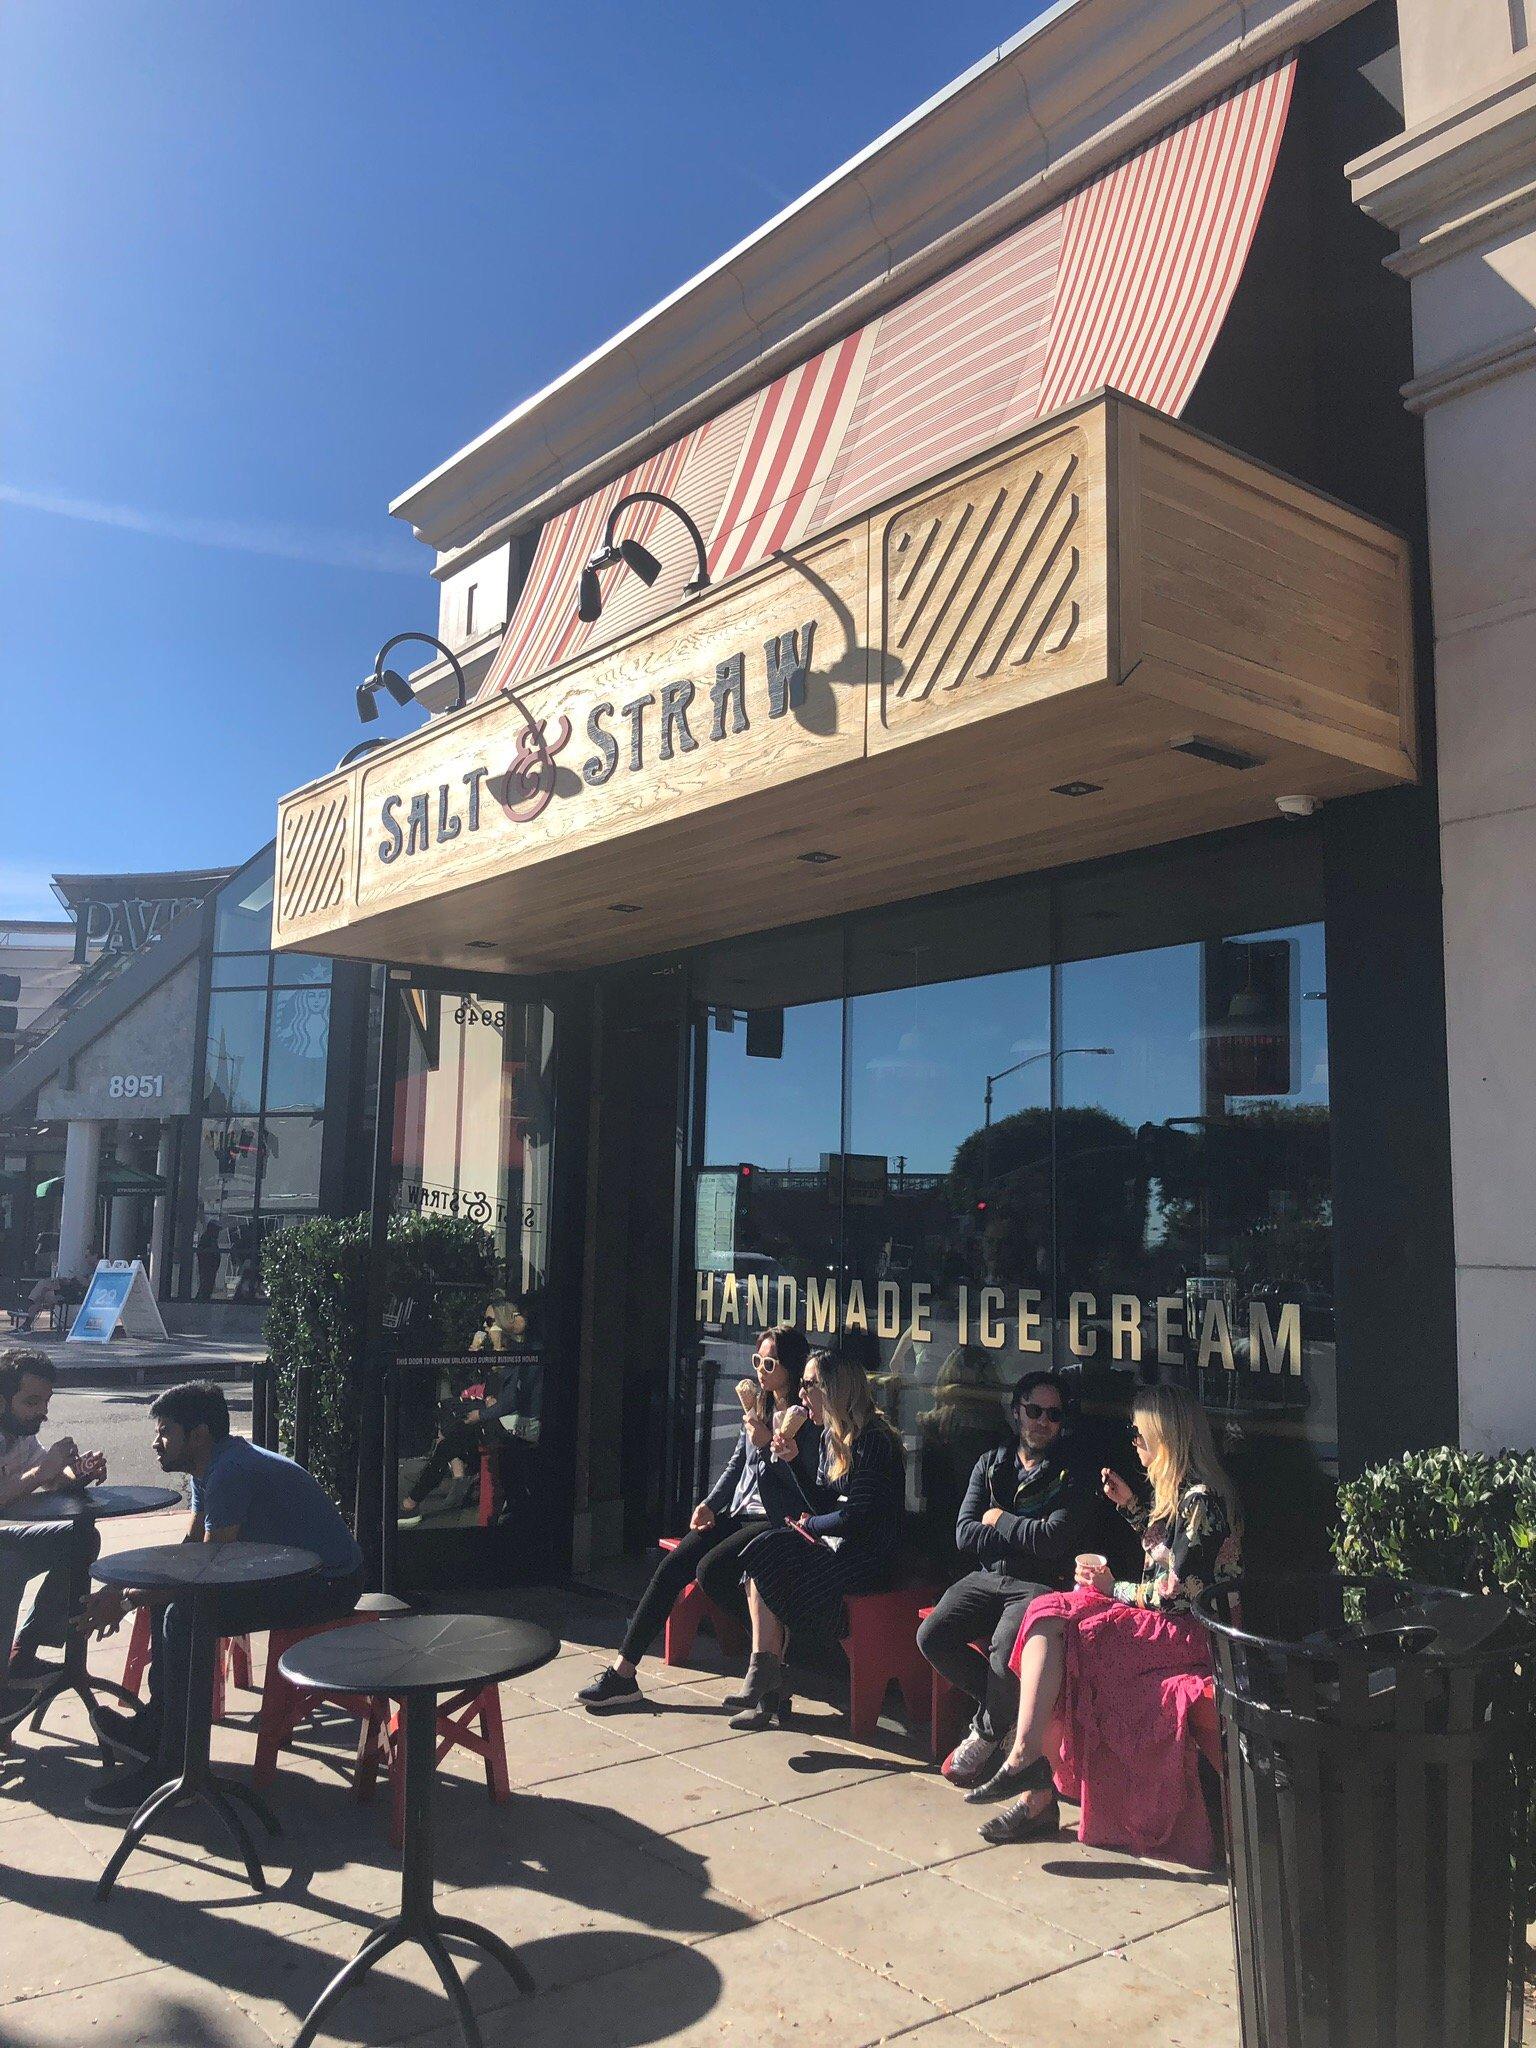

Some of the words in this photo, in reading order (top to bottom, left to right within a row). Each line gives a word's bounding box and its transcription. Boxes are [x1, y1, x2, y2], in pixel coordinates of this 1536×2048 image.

[379, 766, 489, 865] SALT
[502, 714, 572, 822] &
[582, 620, 817, 786] STRAW
[110, 1075, 163, 1098] 8951
[695, 1272, 932, 1342] HANDMADE
[958, 1285, 1041, 1353] ICE
[1069, 1291, 1302, 1376] CREAM
